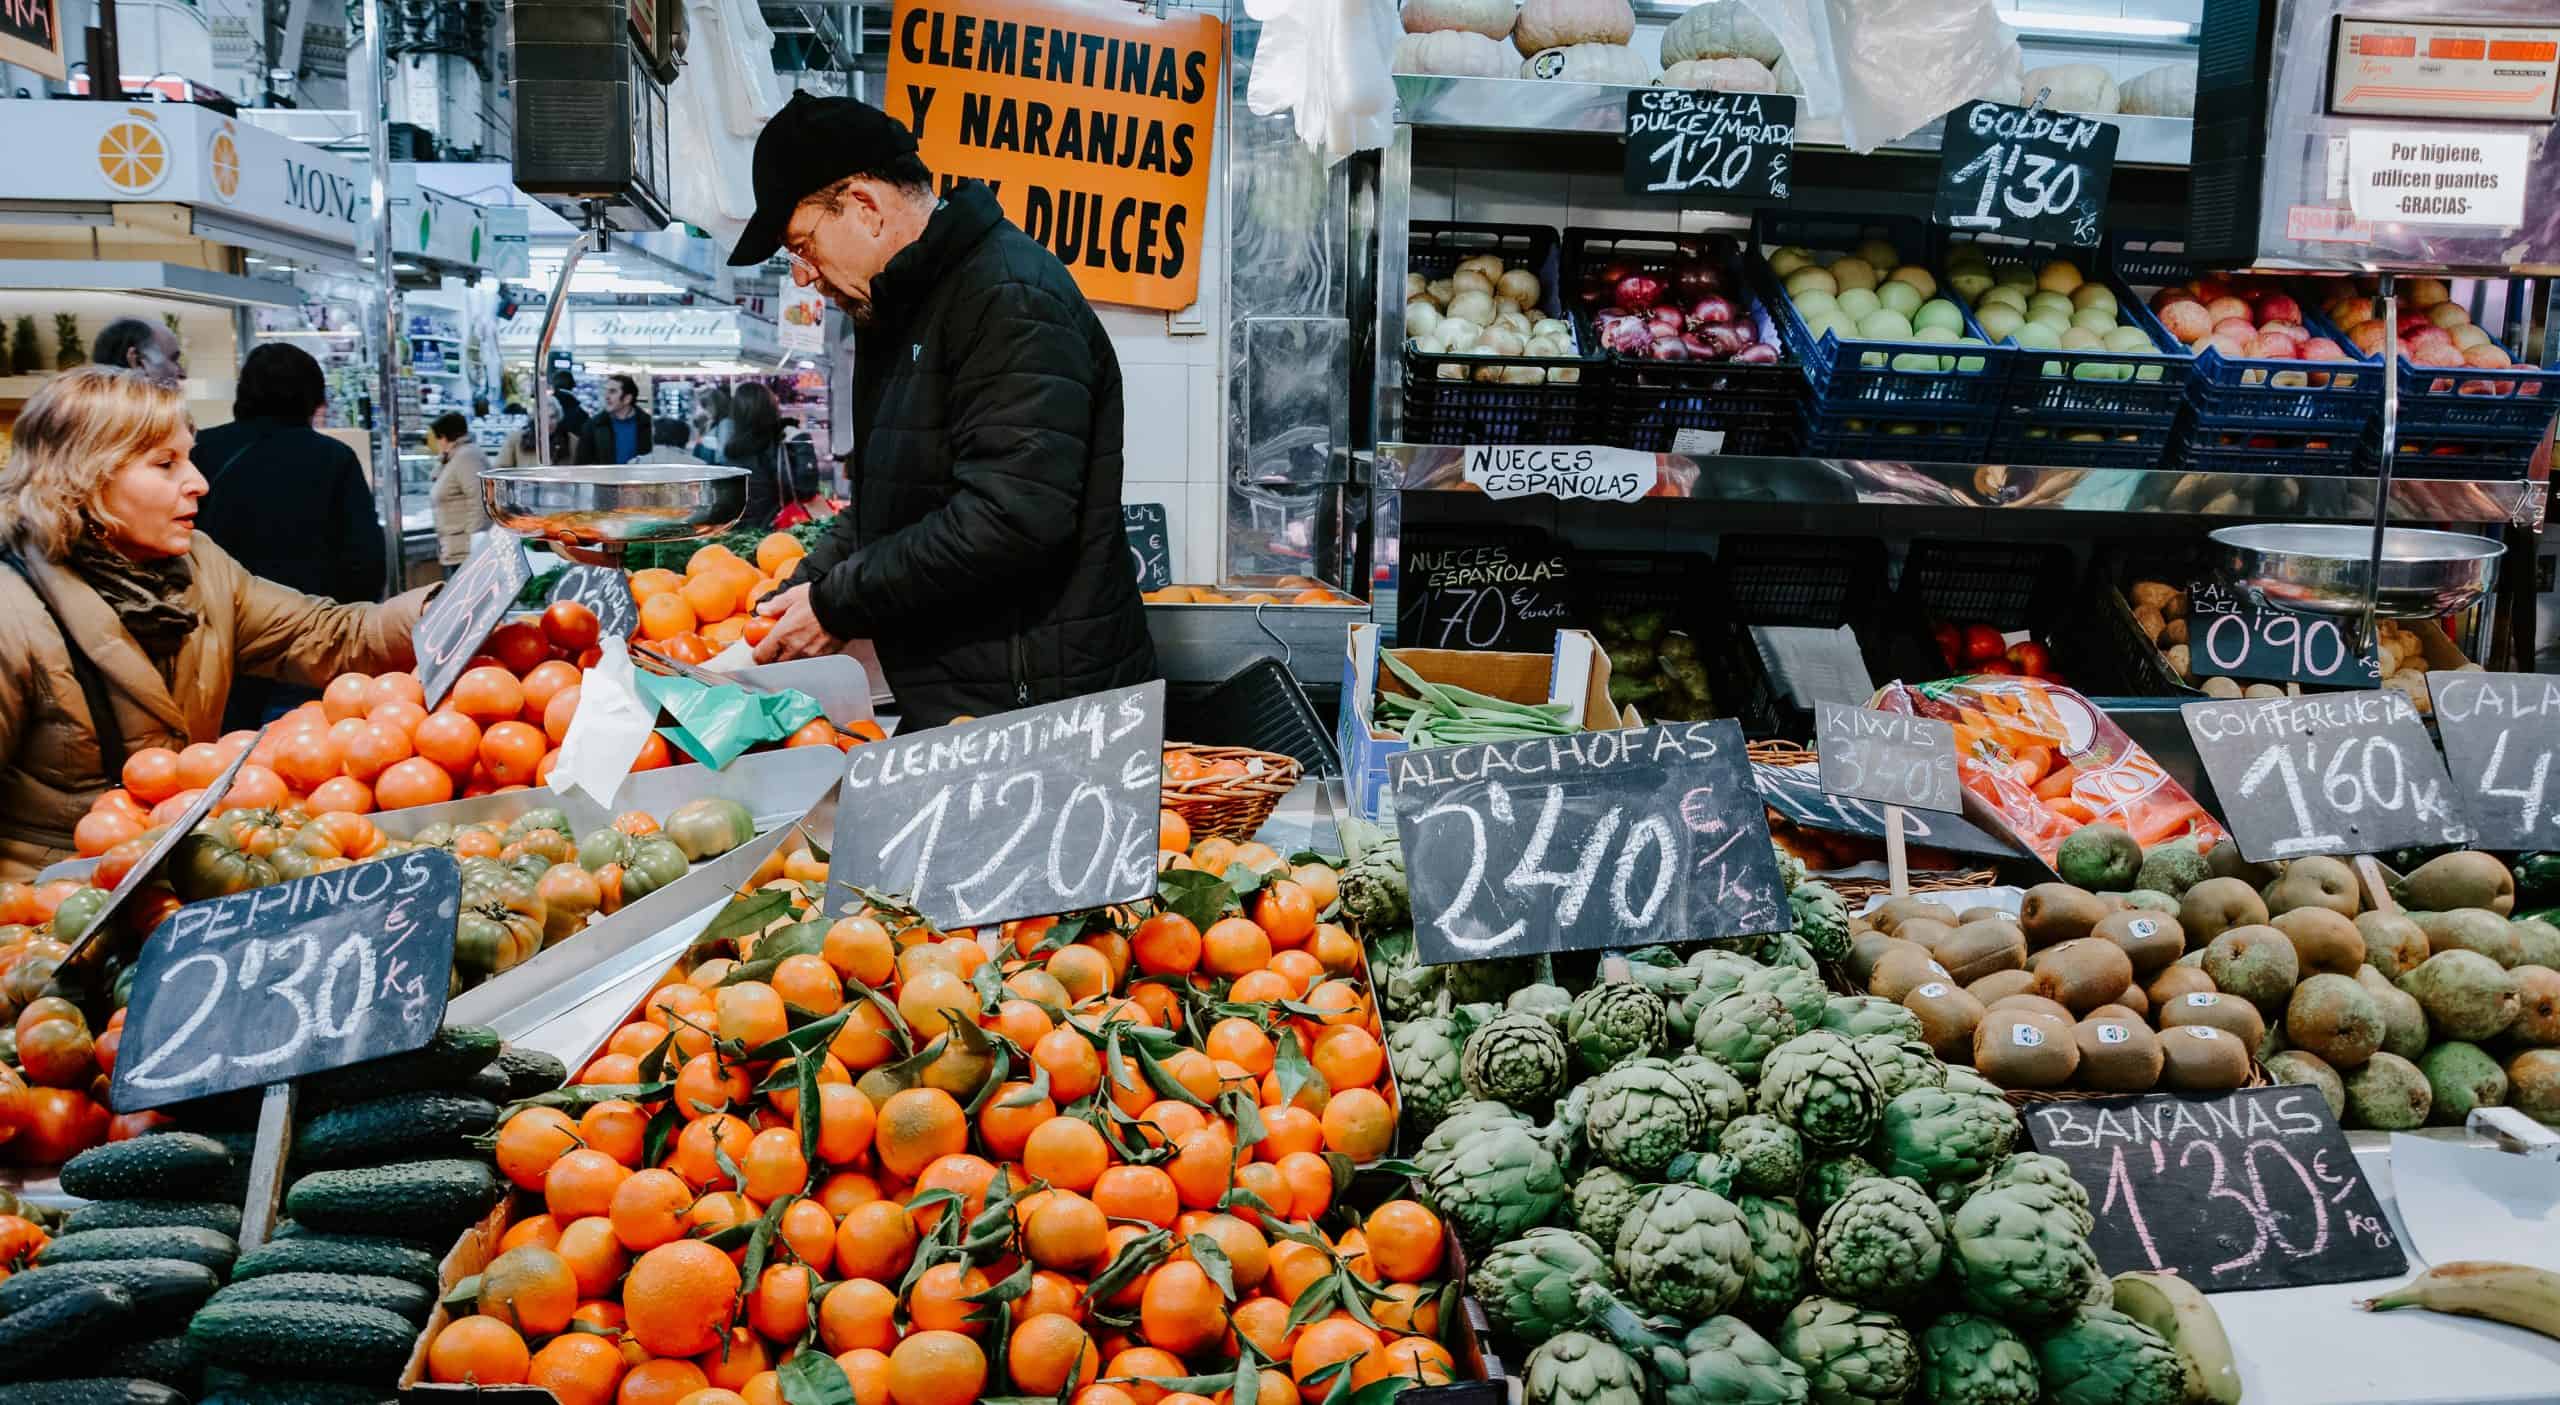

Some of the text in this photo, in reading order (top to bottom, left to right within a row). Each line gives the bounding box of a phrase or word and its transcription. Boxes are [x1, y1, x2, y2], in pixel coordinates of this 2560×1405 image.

[901, 8, 1206, 104] CLEMENTINAS
[907, 84, 1194, 177] Y NARANJAS
[1647, 133, 1753, 191] 1'20
[1969, 102, 2101, 152] GOLDEN
[2391, 143, 2483, 164] Por higiene,
[1950, 142, 2080, 230] 1'30
[2372, 169, 2498, 190] utilicen guantes
[2395, 195, 2472, 215] -GRACIAS-
[1025, 185, 1187, 279] DULCES
[1471, 445, 1593, 473] NUECES
[1486, 472, 1639, 498] ESPAÑOLAS
[1409, 546, 1509, 574] NUECES
[1428, 557, 1568, 587] ESPAÑOLAS
[2194, 600, 2243, 614] DEL
[2206, 607, 2345, 677] 0'90
[850, 691, 1145, 789] CLEMENTINAS
[1396, 720, 1718, 793] ALCACHOFAS
[1825, 707, 1937, 746] KIWIS
[2239, 735, 2405, 856] 1'60
[877, 770, 1114, 921] 1'20
[1410, 782, 1678, 951] 2'40
[168, 854, 431, 952] PEPINOS
[124, 932, 378, 1090] 2'30
[2036, 1096, 2323, 1148] BANANAS
[2101, 1139, 2329, 1275] 1'30
